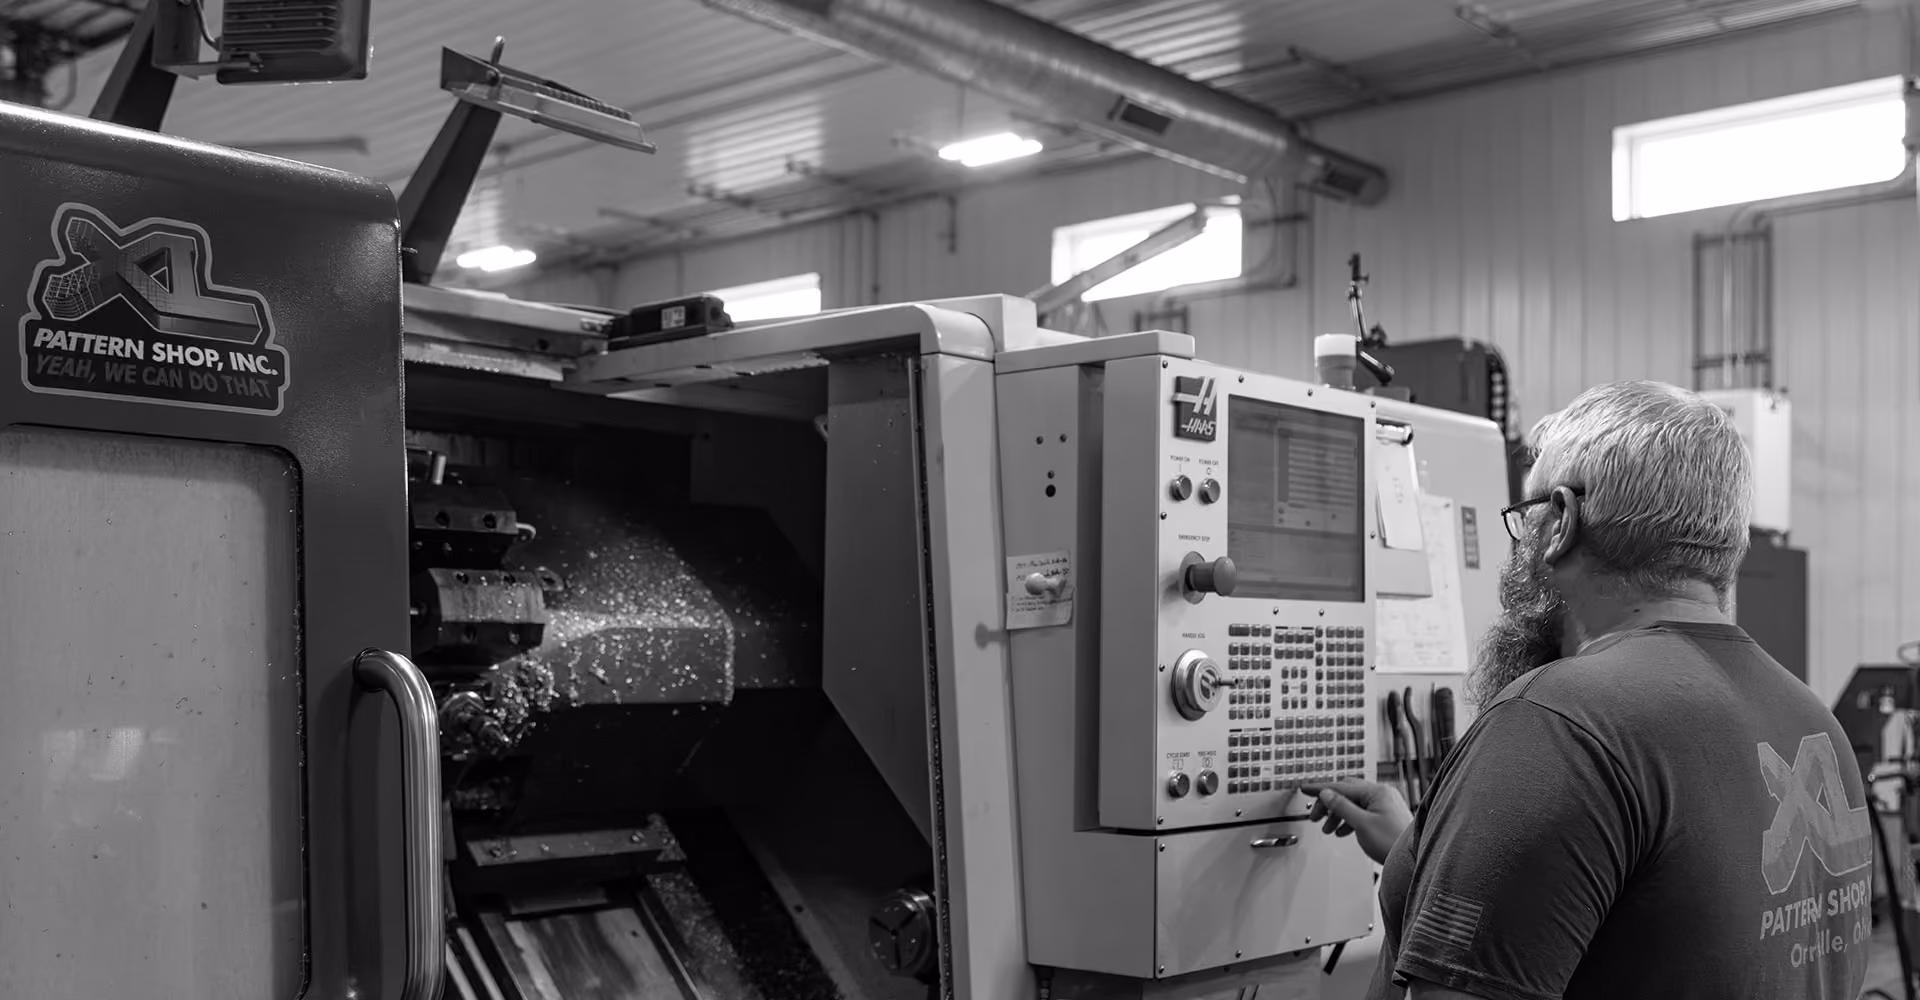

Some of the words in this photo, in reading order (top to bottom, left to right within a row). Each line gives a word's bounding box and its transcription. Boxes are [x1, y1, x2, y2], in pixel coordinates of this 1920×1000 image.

[42, 216, 262, 345] XL
[33, 327, 145, 360] PATTERN
[152, 342, 224, 372] SHOP,
[229, 351, 279, 376] INC.
[36, 354, 97, 384] YEAH,
[105, 361, 137, 384] WE
[142, 366, 183, 389] CAN
[188, 369, 218, 393] DO
[221, 375, 272, 400] THAT
[1757, 732, 1872, 895] XL
